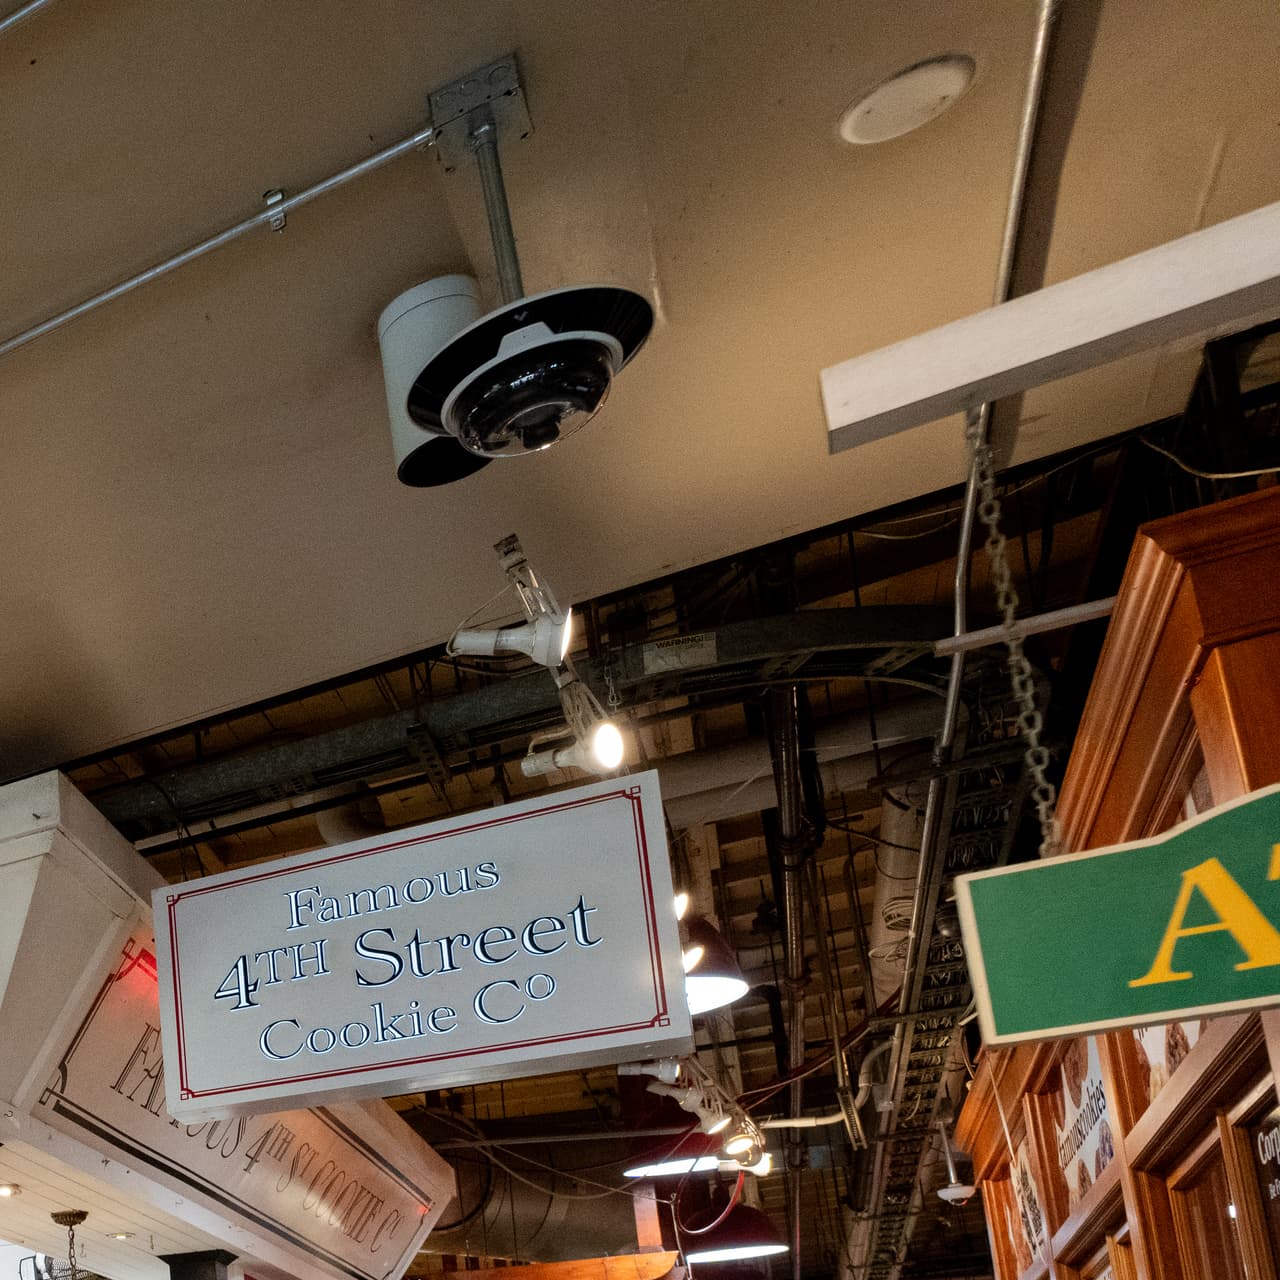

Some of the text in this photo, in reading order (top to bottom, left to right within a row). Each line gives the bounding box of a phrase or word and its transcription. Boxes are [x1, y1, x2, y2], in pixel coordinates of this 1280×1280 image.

[214, 894, 603, 1011] 4TH Street
[282, 862, 500, 931] Famous
[1128, 842, 1280, 988] A
[259, 1001, 458, 1061] Cookie
[243, 1120, 297, 1174] 4TH
[302, 1160, 385, 1244] COOKIE
